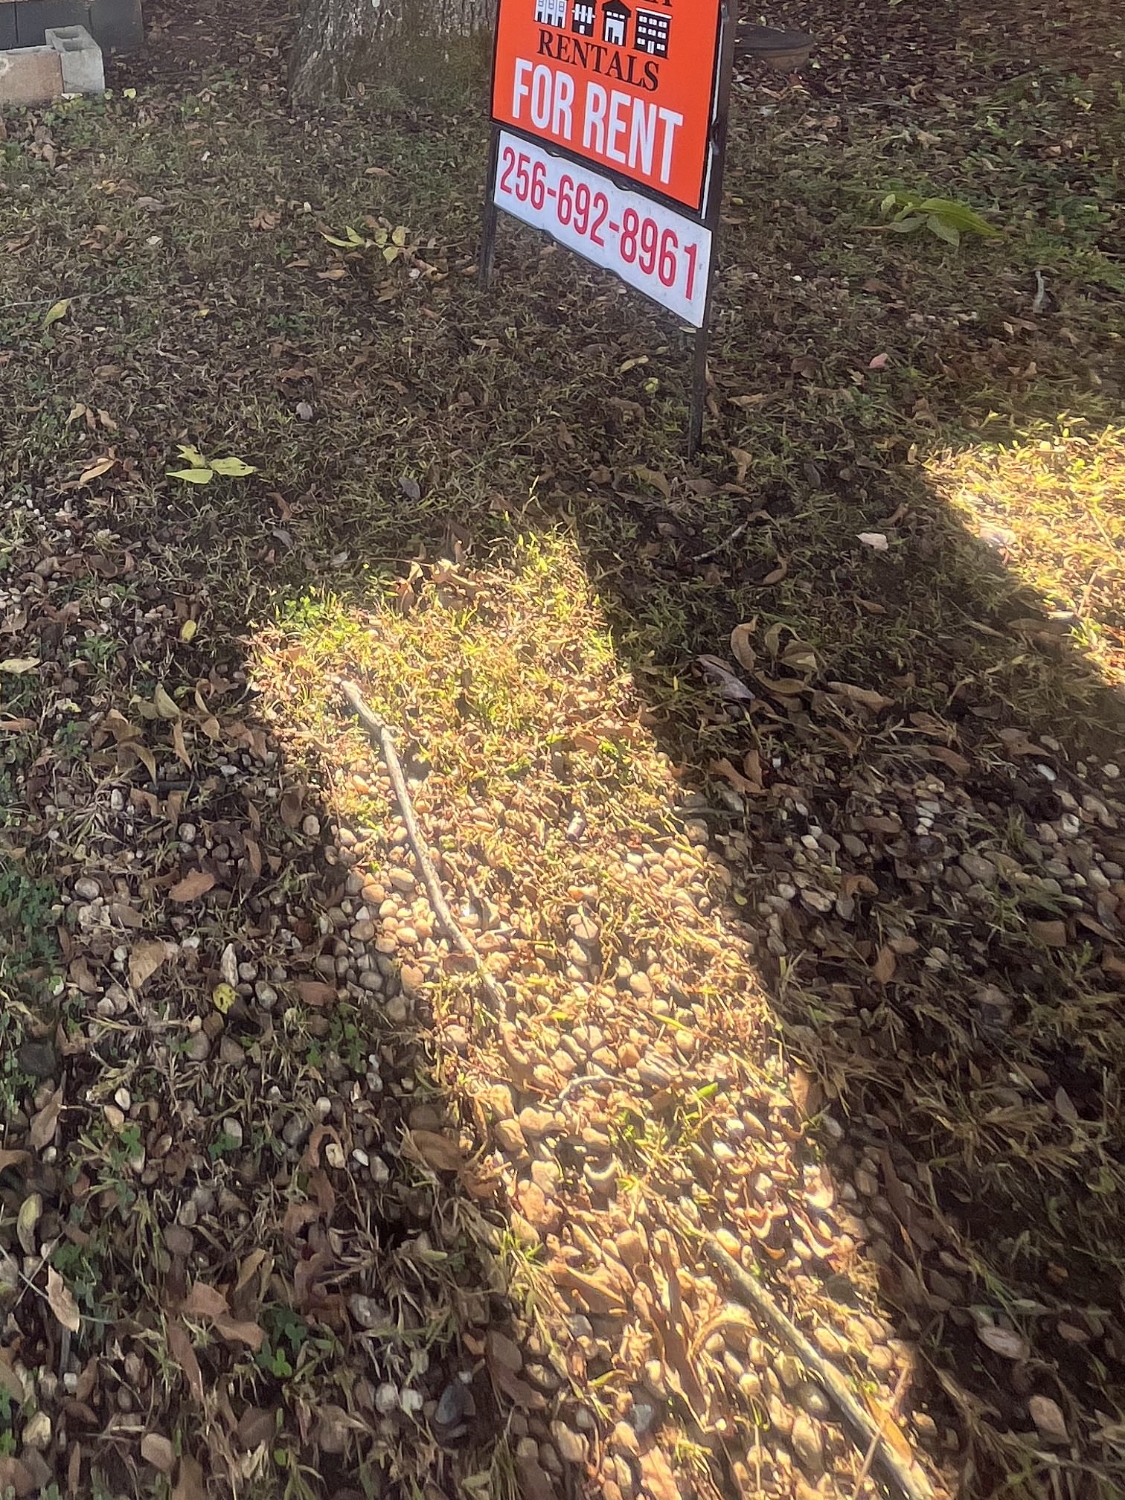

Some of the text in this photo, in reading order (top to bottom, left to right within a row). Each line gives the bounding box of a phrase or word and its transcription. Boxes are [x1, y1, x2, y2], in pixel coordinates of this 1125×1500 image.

[511, 57, 684, 185] FOR RENT
[536, 28, 660, 92] RENTALS
[499, 146, 699, 301] 256-692-8961
